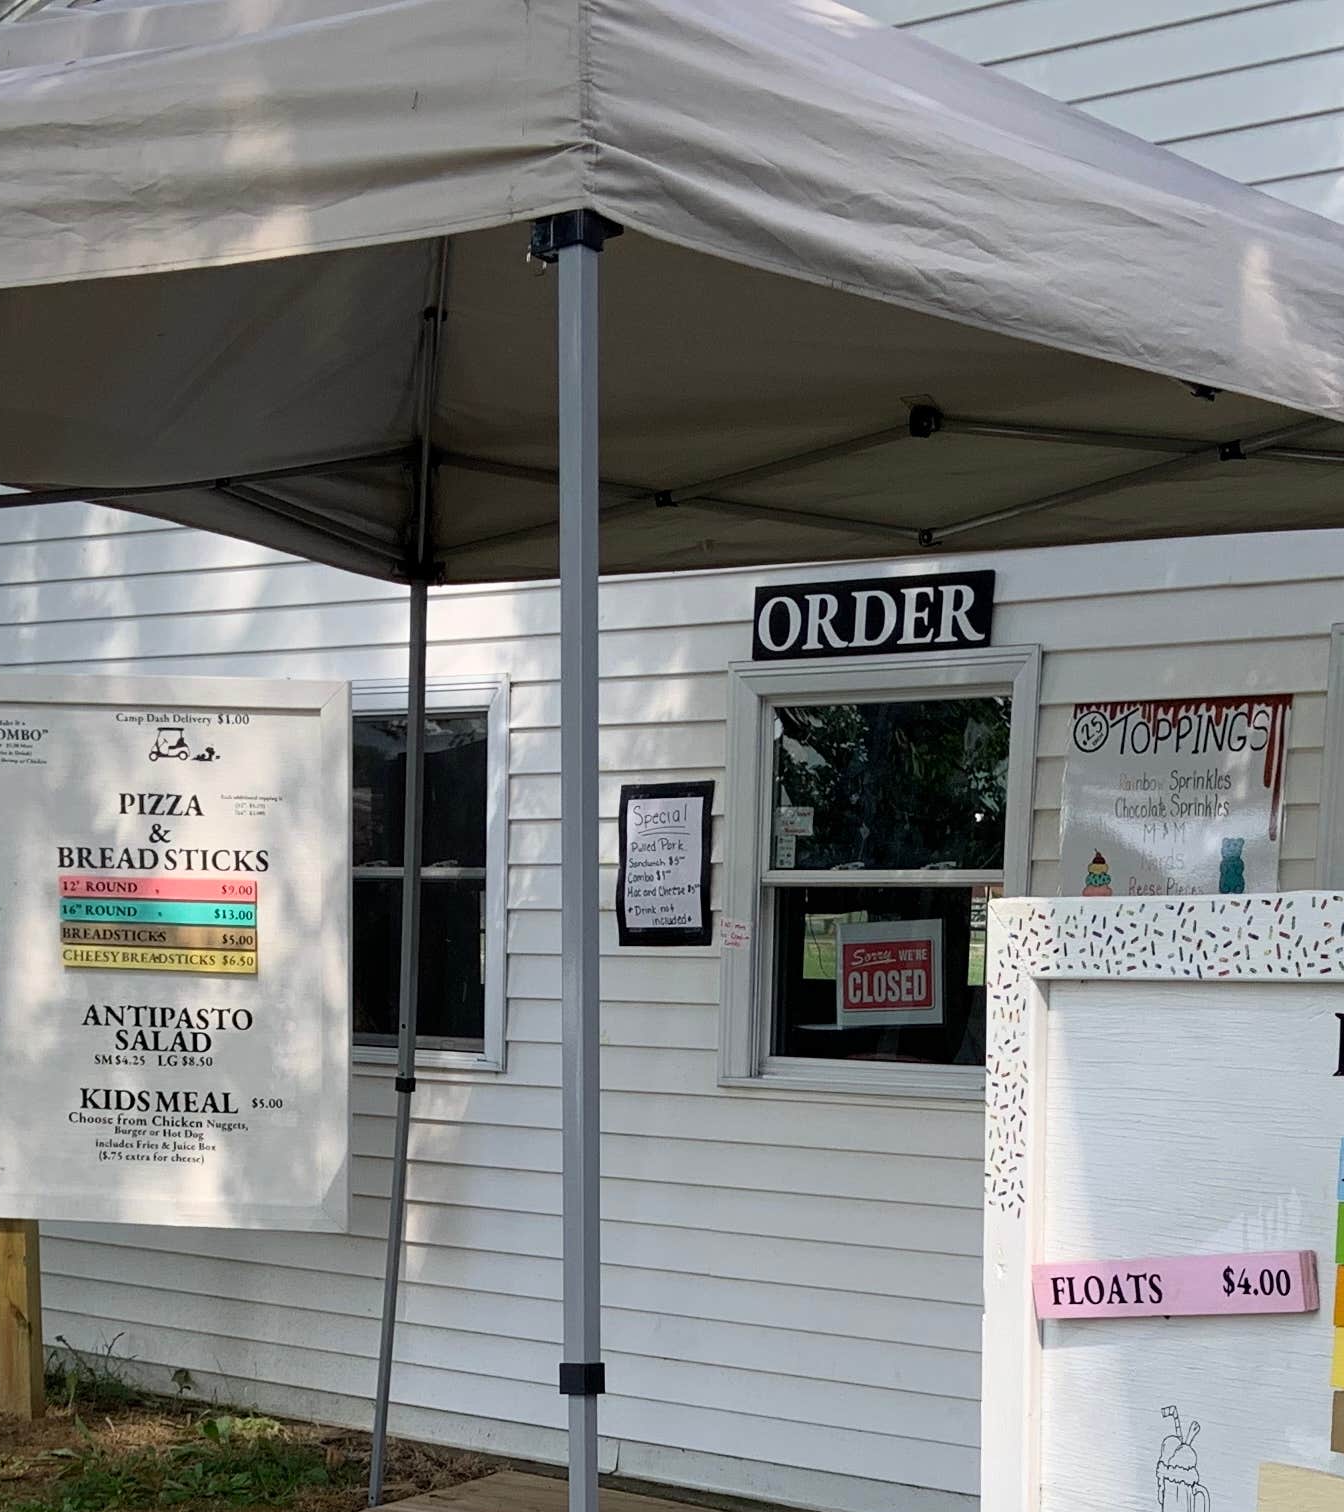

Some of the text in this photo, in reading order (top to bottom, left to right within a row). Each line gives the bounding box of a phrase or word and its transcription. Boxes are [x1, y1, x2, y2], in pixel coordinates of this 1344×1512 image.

[758, 584, 985, 652] ORDER
[116, 713, 249, 726] Camp Dash Delivery $1.00
[1110, 706, 1270, 755] TOPPINGS
[1169, 768, 1231, 792] Sprinkles
[119, 792, 205, 817] PIZZA
[1115, 797, 1166, 818] Chocolate
[633, 804, 687, 828] Special
[148, 823, 171, 844] &
[658, 838, 684, 850] Pork
[85, 881, 138, 893] ROUND
[221, 884, 253, 896] $9.00
[84, 904, 137, 917] ROUND
[214, 909, 253, 921] $13.00
[62, 927, 167, 942] BREADSTICKS
[222, 934, 253, 946] $5.00
[222, 955, 254, 967] $6.50
[851, 949, 928, 967] Sorry WE'RE
[848, 969, 927, 1003] CLOSED
[81, 1004, 253, 1031] ANTIPASTO
[114, 1029, 212, 1053] SALAD
[93, 1055, 213, 1067] SM LG $8.50
[79, 1087, 283, 1115] KIDS MEAL $5.00
[68, 1112, 203, 1129] Choose from Chicken
[114, 1126, 204, 1141] Burger Hot Dog
[95, 1139, 134, 1148] includes
[125, 1153, 167, 1162] extra for
[1051, 1272, 1163, 1305] FLOATS
[1222, 1265, 1291, 1297] $4.00
